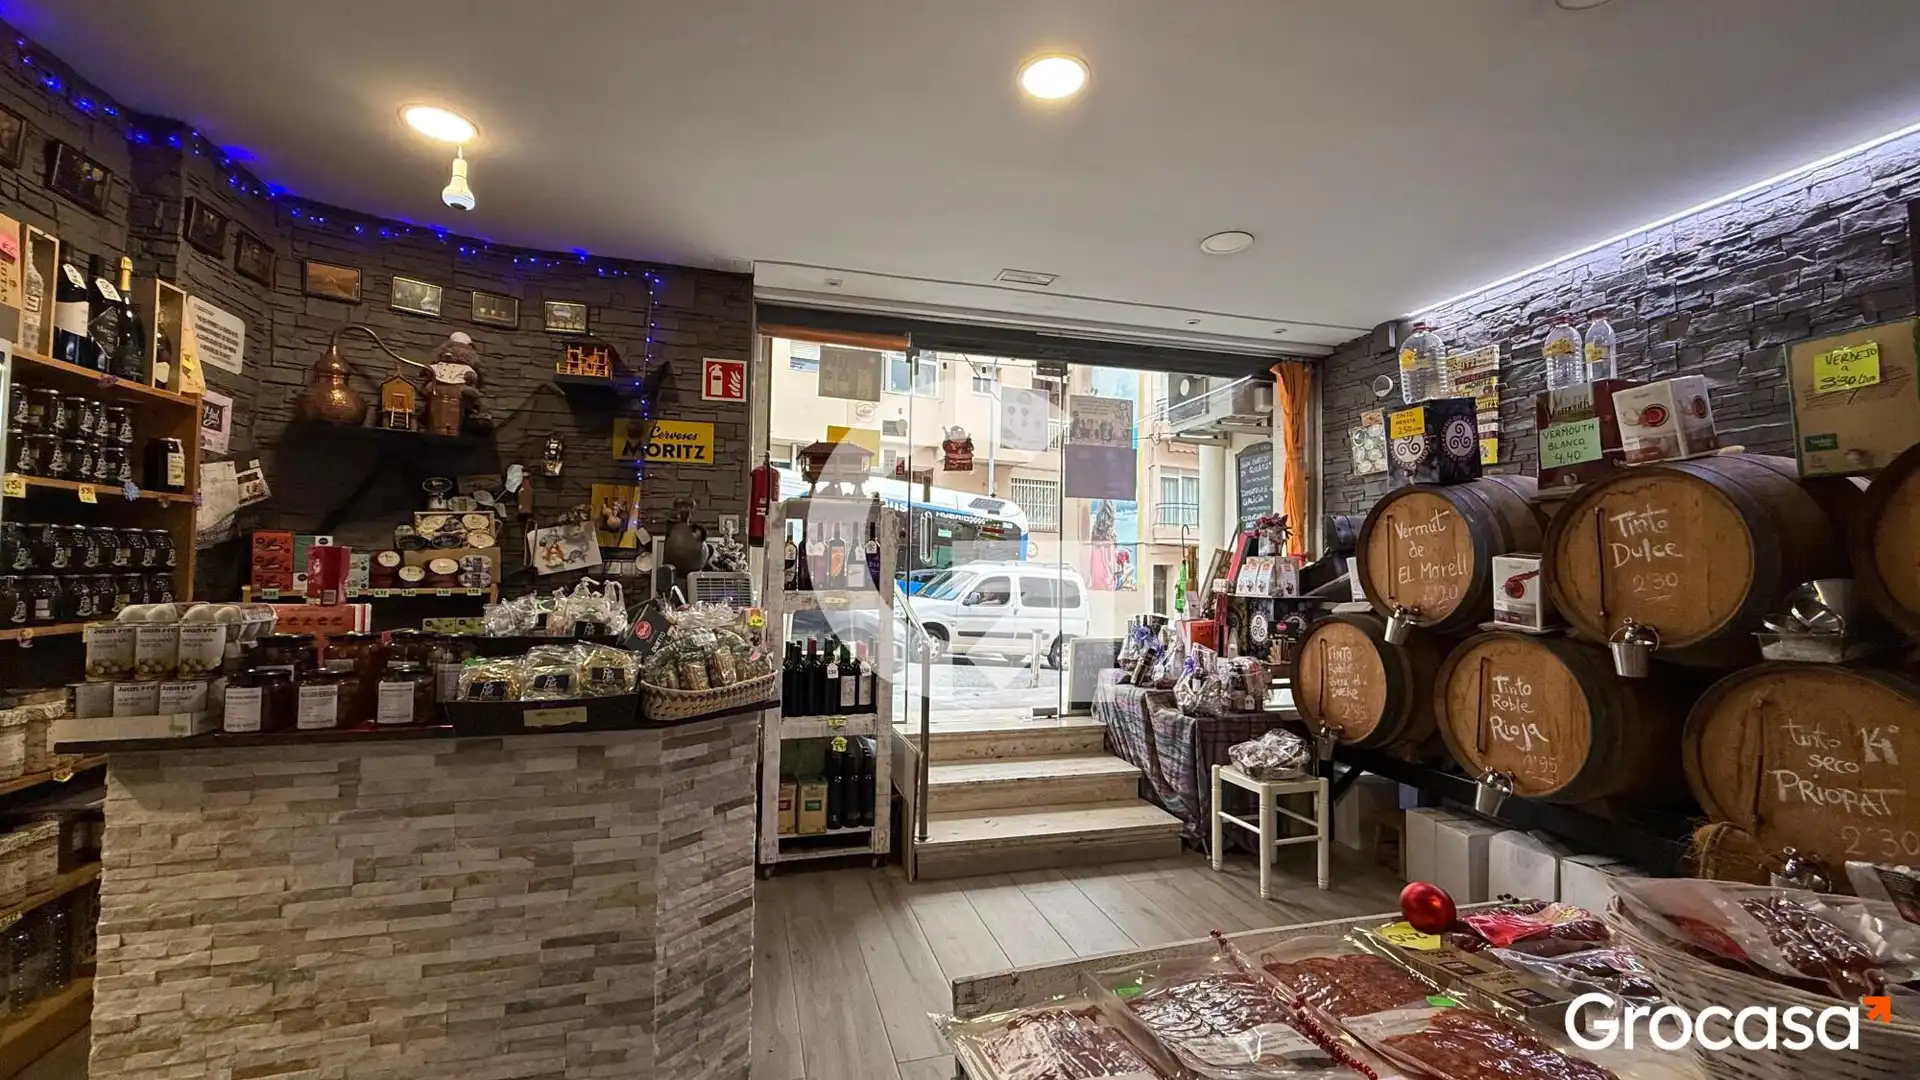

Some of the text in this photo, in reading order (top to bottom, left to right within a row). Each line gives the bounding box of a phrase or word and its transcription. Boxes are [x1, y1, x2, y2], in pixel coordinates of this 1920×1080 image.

[1825, 348, 1877, 366] VERDEJO
[650, 424, 698, 441] Cerveses
[1543, 424, 1594, 440] VERMOUTH
[622, 440, 704, 460] MORITZ
[1548, 438, 1585, 452] BLANCO
[936, 511, 970, 523] HYBRID
[1395, 508, 1450, 540] Vermut
[1608, 504, 1668, 538] Tinto
[1409, 540, 1424, 558] de
[1608, 538, 1684, 568] Dulce
[1420, 552, 1470, 579] Morell
[1328, 644, 1352, 661] TINTO
[1491, 676, 1532, 696] Tinto
[1491, 694, 1534, 713] Roble
[1489, 715, 1550, 752] Rioja
[1807, 754, 1860, 774] seco
